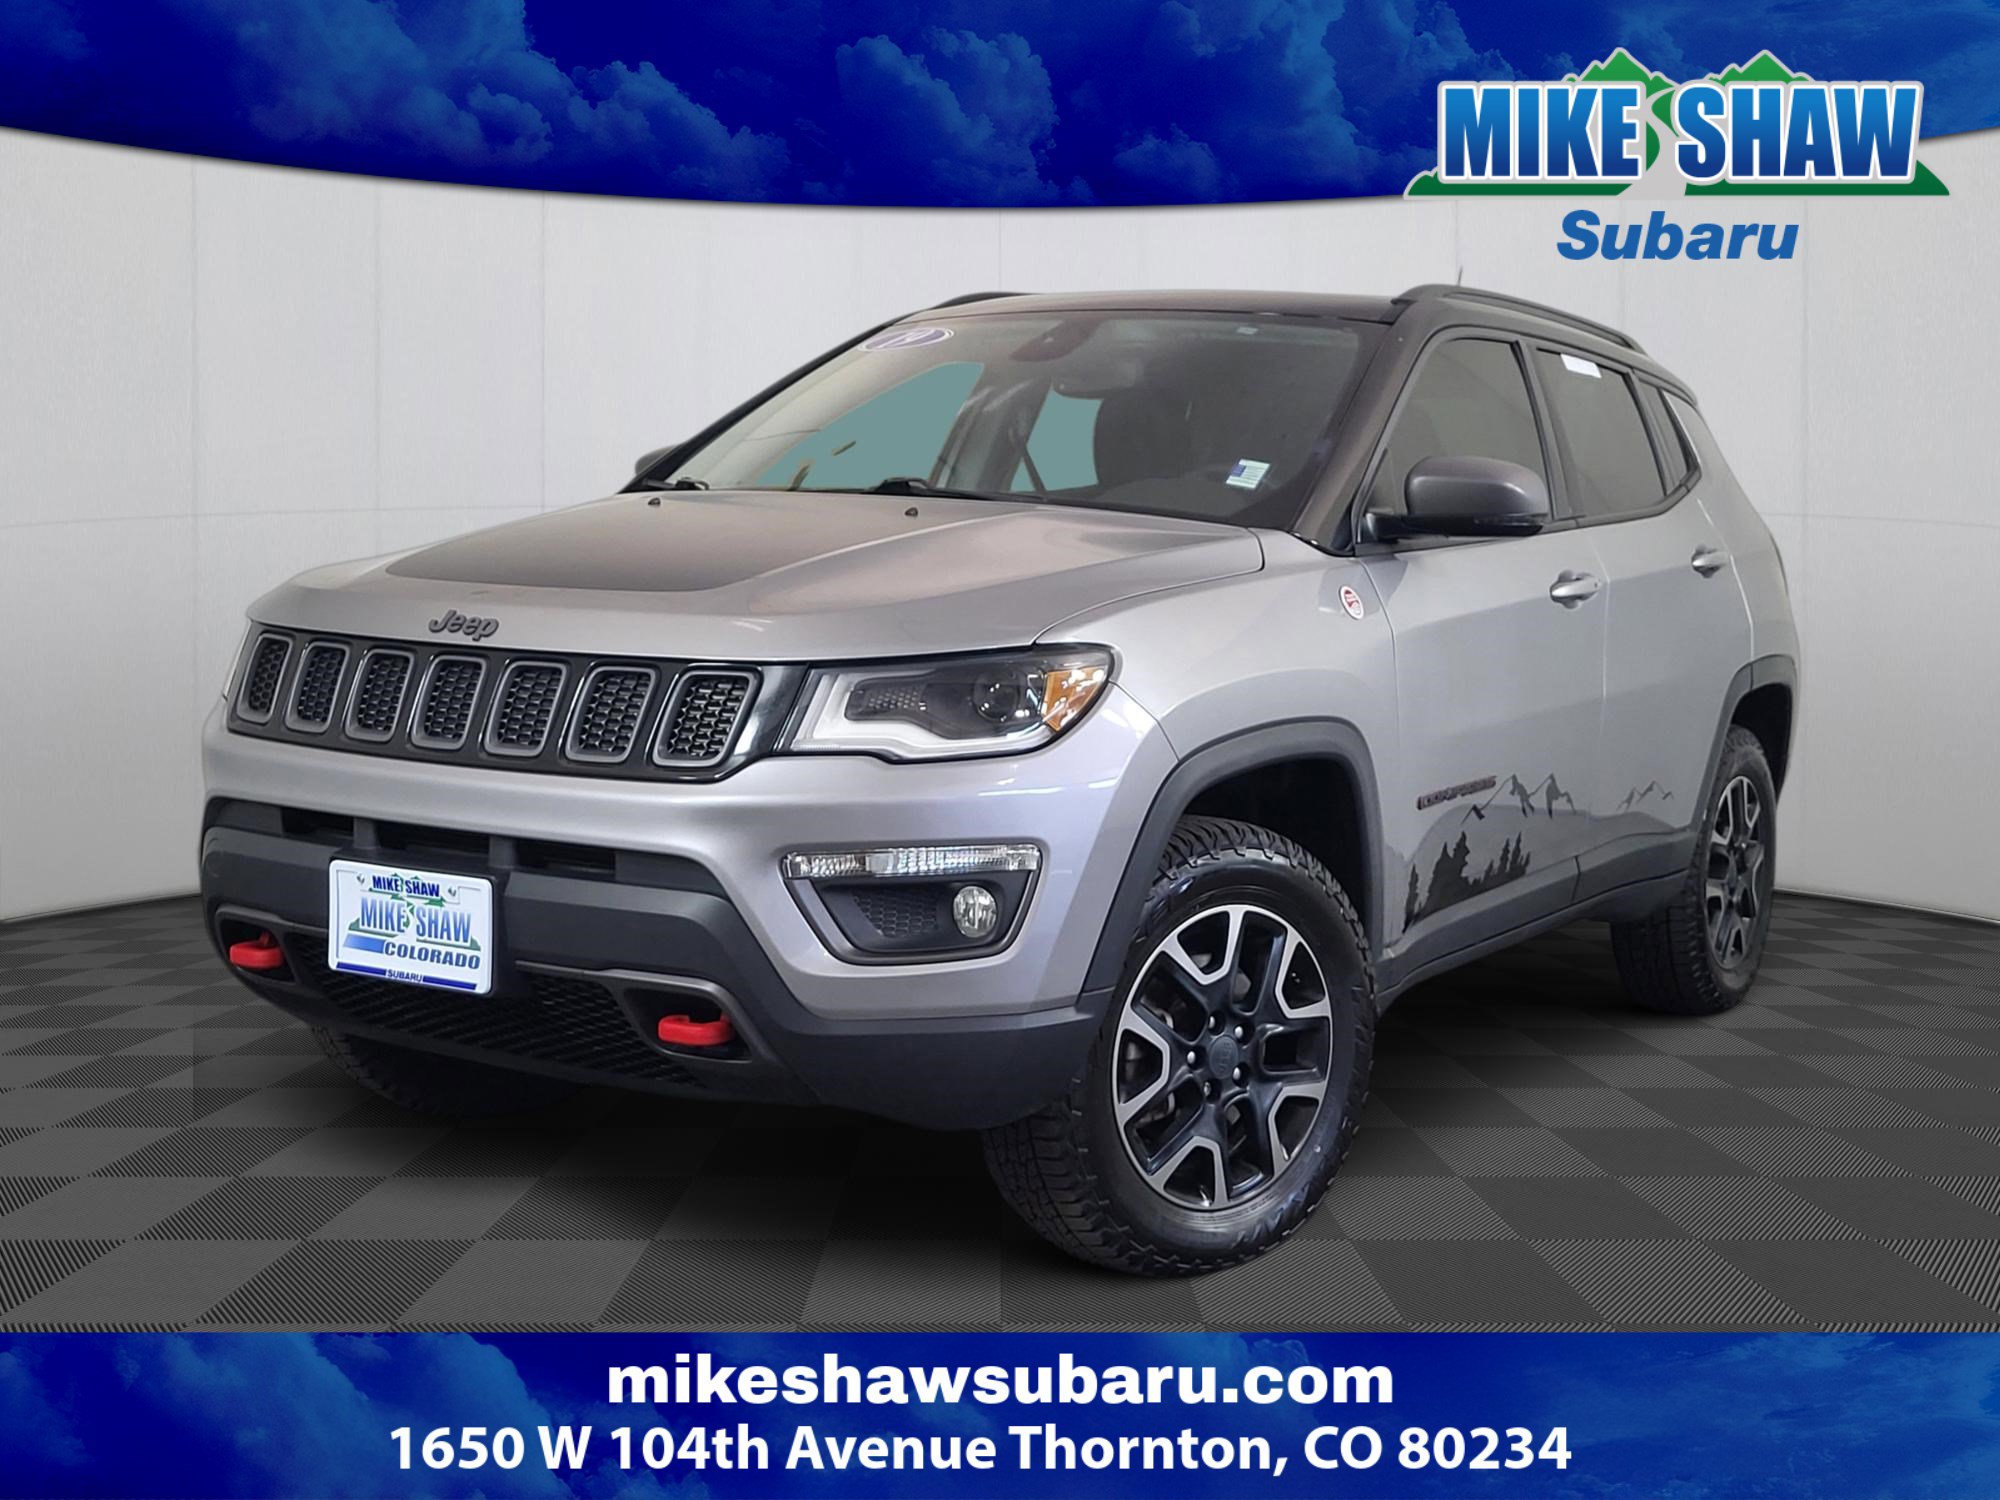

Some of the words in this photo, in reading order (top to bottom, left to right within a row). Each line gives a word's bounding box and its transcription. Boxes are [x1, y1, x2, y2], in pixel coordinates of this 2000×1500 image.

[428, 609, 500, 642] Jeep
[372, 875, 402, 892] MIKE
[405, 881, 440, 897] SHAW
[361, 896, 406, 933] MIKE
[416, 906, 472, 943] SHAW
[384, 941, 481, 970] COLORADO
[387, 970, 423, 982] SUBARU
